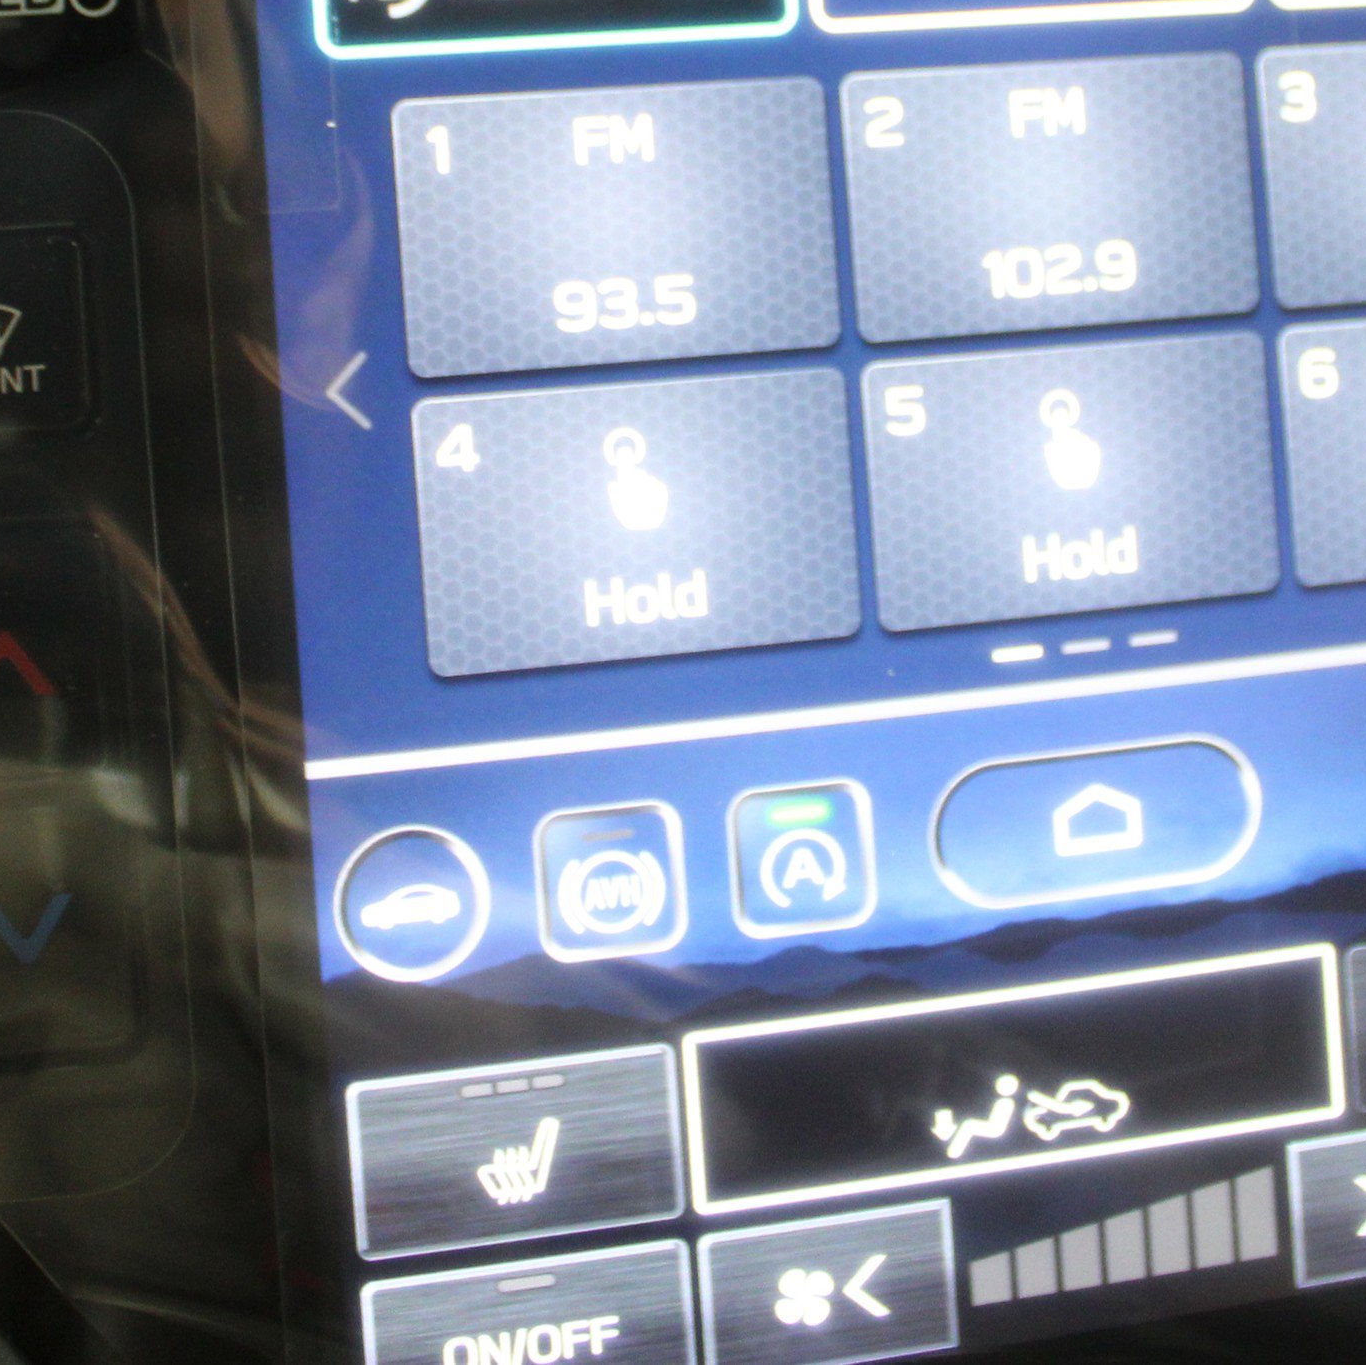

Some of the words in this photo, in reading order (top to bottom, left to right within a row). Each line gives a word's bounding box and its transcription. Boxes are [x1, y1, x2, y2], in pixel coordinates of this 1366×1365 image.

[862, 97, 905, 148] 2
[1007, 87, 1087, 138] FM
[1277, 71, 1318, 123] 3
[425, 125, 452, 175] 1
[571, 113, 655, 166] FM
[981, 239, 1139, 300] 102.9
[552, 274, 698, 334] 93.5
[1297, 348, 1340, 400] 6
[884, 385, 927, 437] 5
[435, 423, 481, 472] 4
[1021, 527, 1139, 585] Hold
[583, 570, 710, 628] Hold
[442, 1315, 620, 1365] ON/OFF
